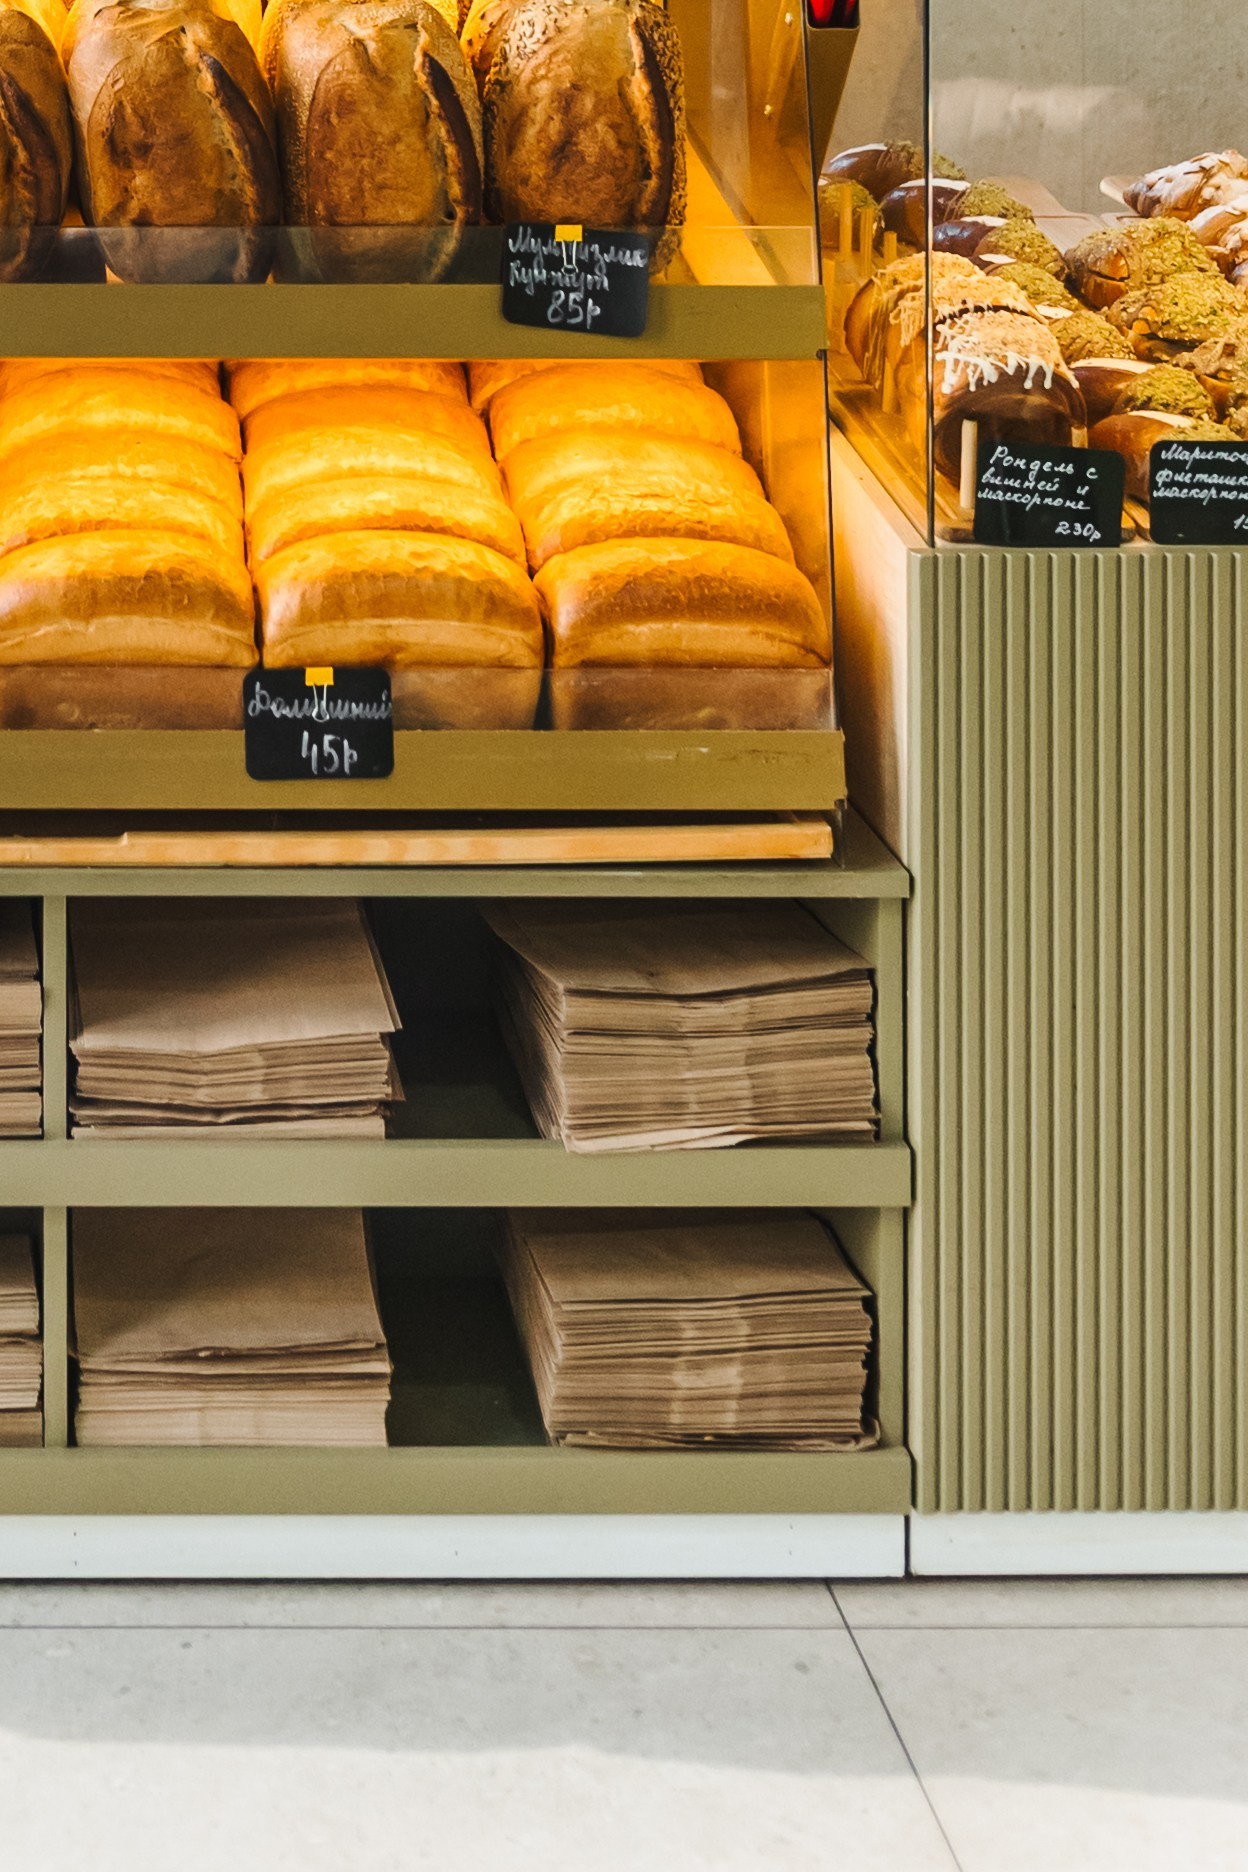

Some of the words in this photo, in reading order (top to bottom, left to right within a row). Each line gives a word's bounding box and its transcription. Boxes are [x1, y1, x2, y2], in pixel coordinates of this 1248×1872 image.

[547, 290, 601, 329] 85р
[981, 466, 1060, 491] вишней
[1076, 485, 1090, 496] и
[989, 445, 1074, 481] Рондель
[1086, 467, 1099, 479] с
[1055, 521, 1102, 543] 230р
[301, 730, 358, 775] 45р
